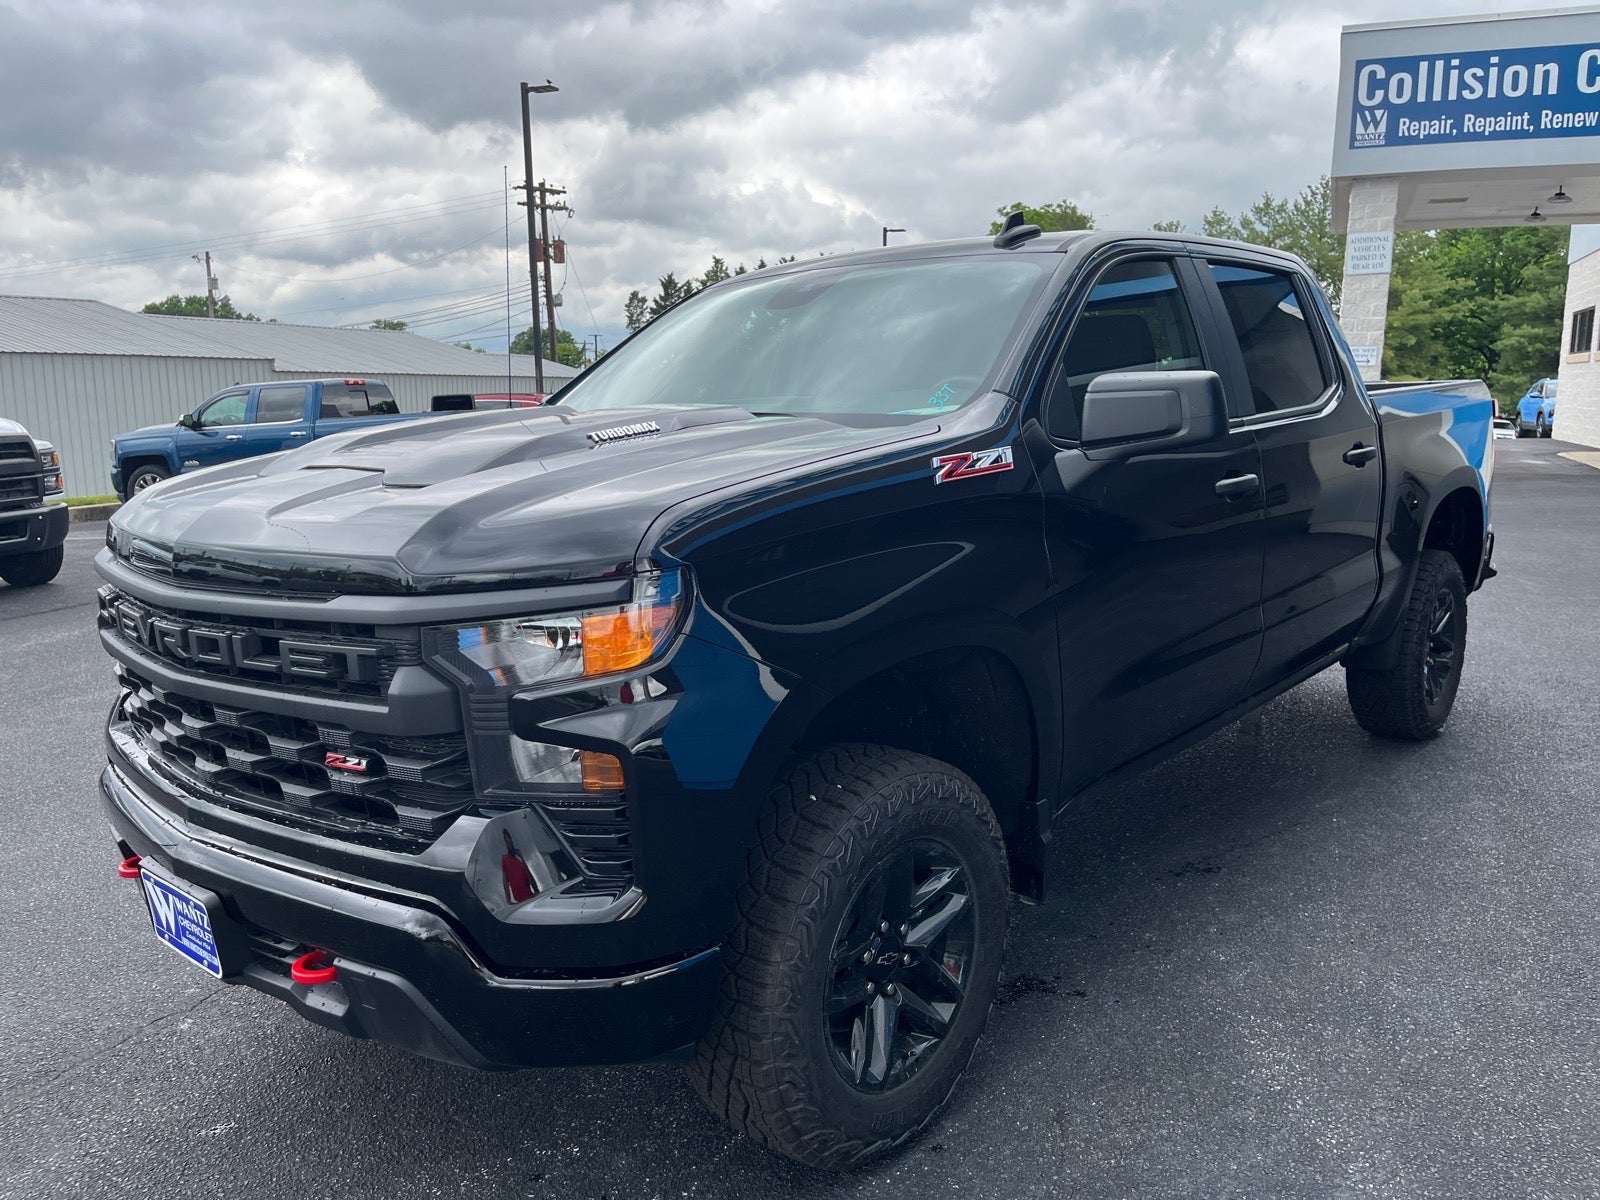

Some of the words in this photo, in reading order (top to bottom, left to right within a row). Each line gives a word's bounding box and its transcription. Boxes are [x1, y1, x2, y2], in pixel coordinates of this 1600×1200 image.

[1358, 56, 1559, 107] Collision
[1398, 116, 1457, 139] Repair,
[1463, 112, 1534, 135] Repaint,
[1540, 109, 1600, 129] Renew
[1356, 133, 1385, 141] WANTZ
[1351, 236, 1389, 244] ADDITIONAL
[1353, 245, 1386, 253] VEHICLES
[1351, 253, 1377, 262] PARKED
[1352, 262, 1370, 270] REAR
[587, 420, 661, 443] TURBOMAX
[931, 445, 1014, 485] Z71
[324, 752, 367, 773] Z71
[173, 895, 211, 930] WANTZ
[178, 915, 213, 944] CHEVROLET
